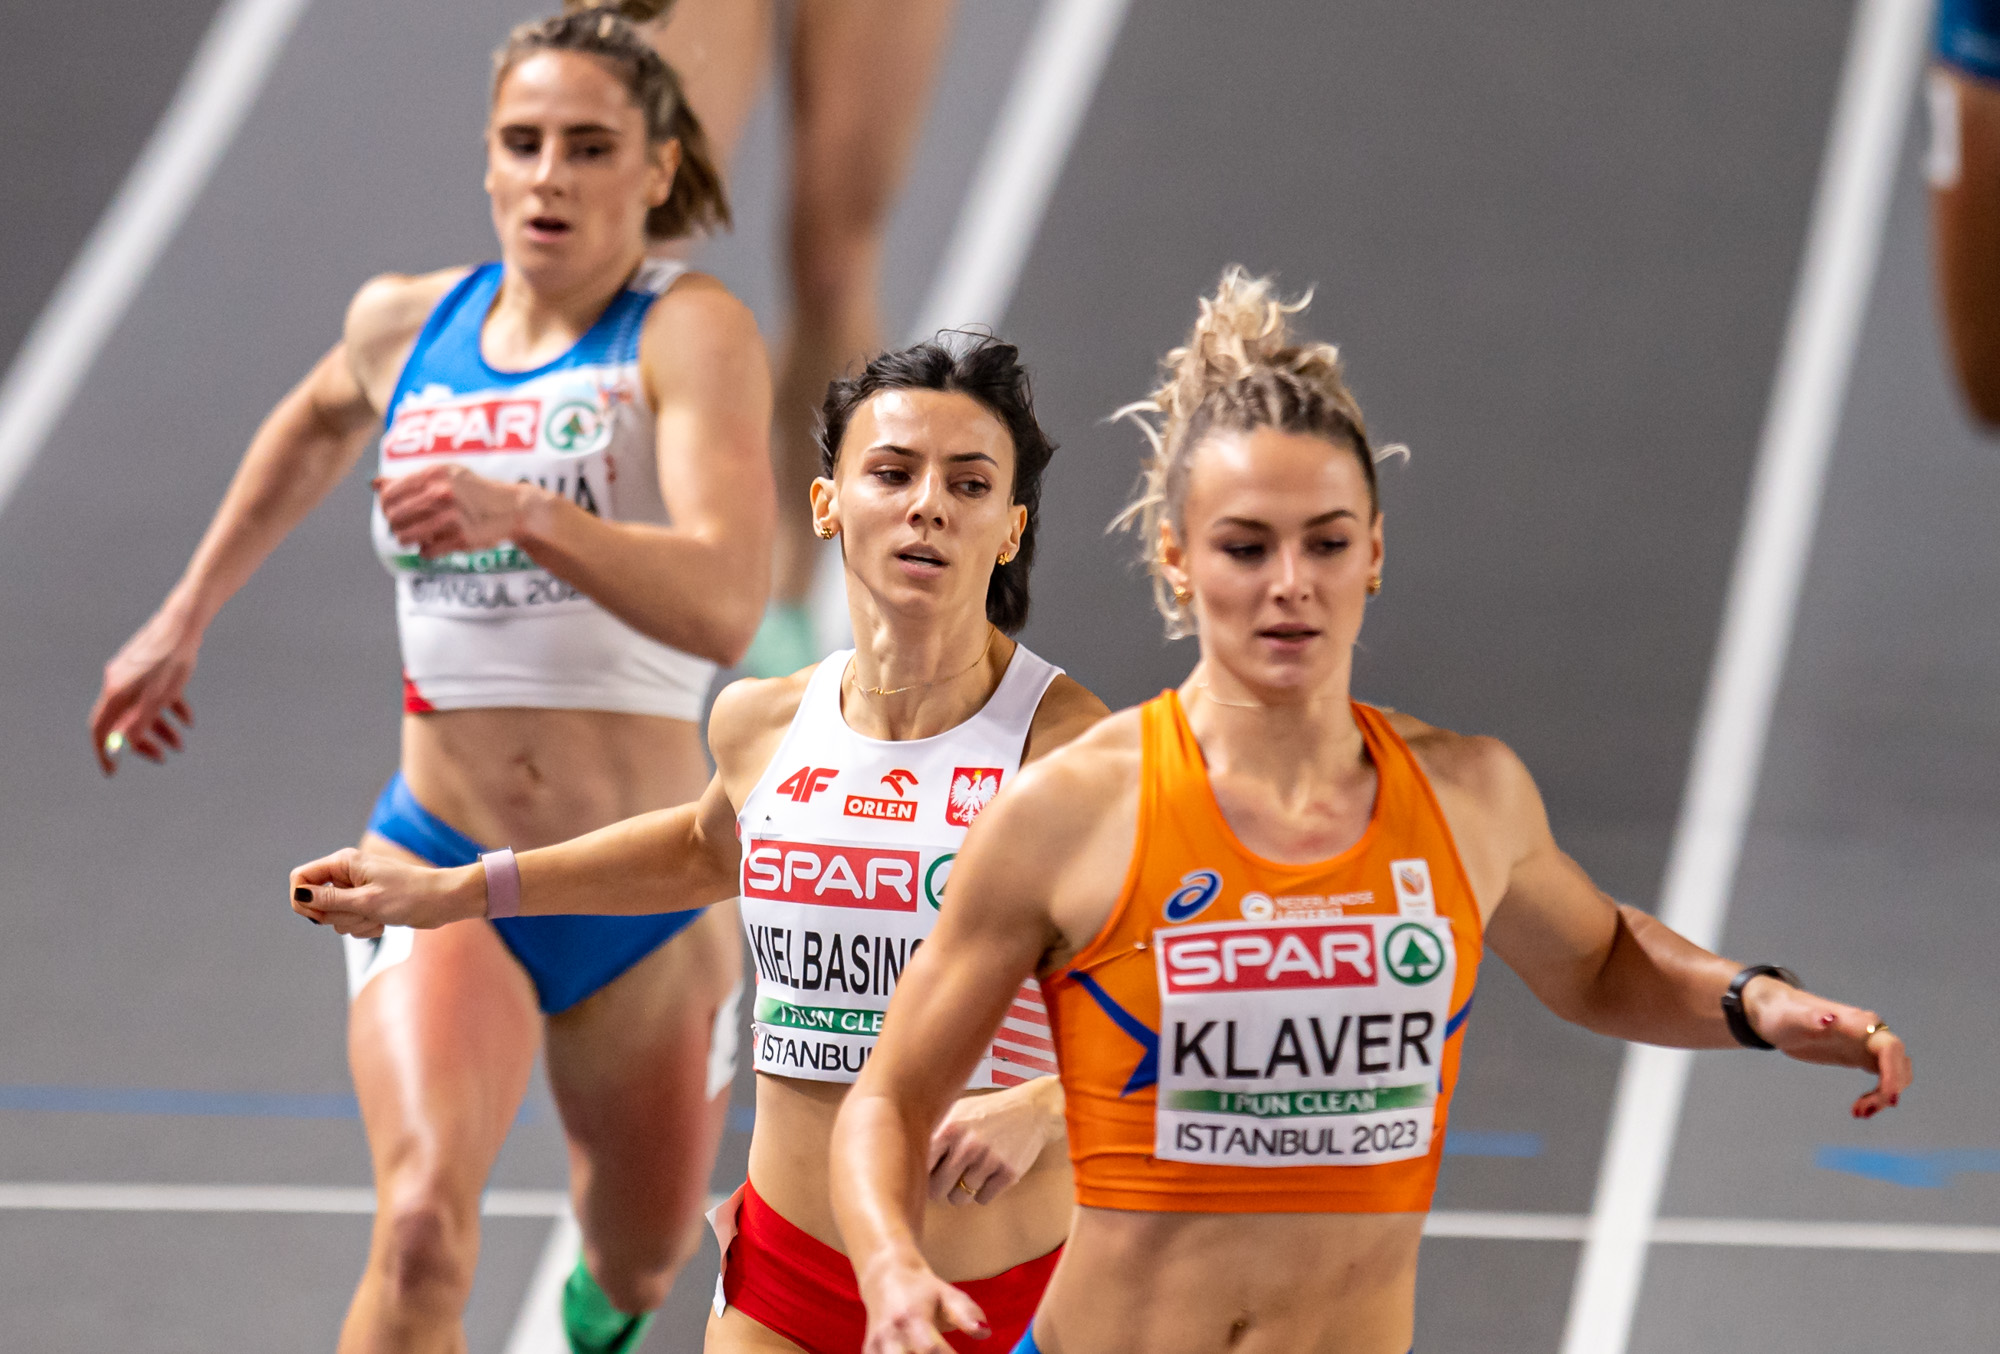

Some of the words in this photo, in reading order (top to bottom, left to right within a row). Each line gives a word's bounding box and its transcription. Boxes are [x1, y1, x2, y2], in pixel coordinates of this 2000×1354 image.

[391, 407, 533, 453] SPAR
[777, 766, 839, 802] 4F
[849, 800, 913, 819] ORLEN
[748, 848, 912, 902] SPAR
[749, 923, 925, 997] KIELBASIN
[1169, 933, 1373, 986] SPAR
[779, 1003, 786, 1023] I
[791, 1006, 834, 1029] RUN
[761, 1032, 872, 1073] ISTANBU
[1173, 1011, 1434, 1079] KLAVER
[1220, 1093, 1228, 1111] I
[1235, 1093, 1291, 1116] RUN
[1294, 1090, 1379, 1114] CLEAN
[1175, 1122, 1344, 1157] ISTANBUL
[1351, 1119, 1419, 1155] 2023
